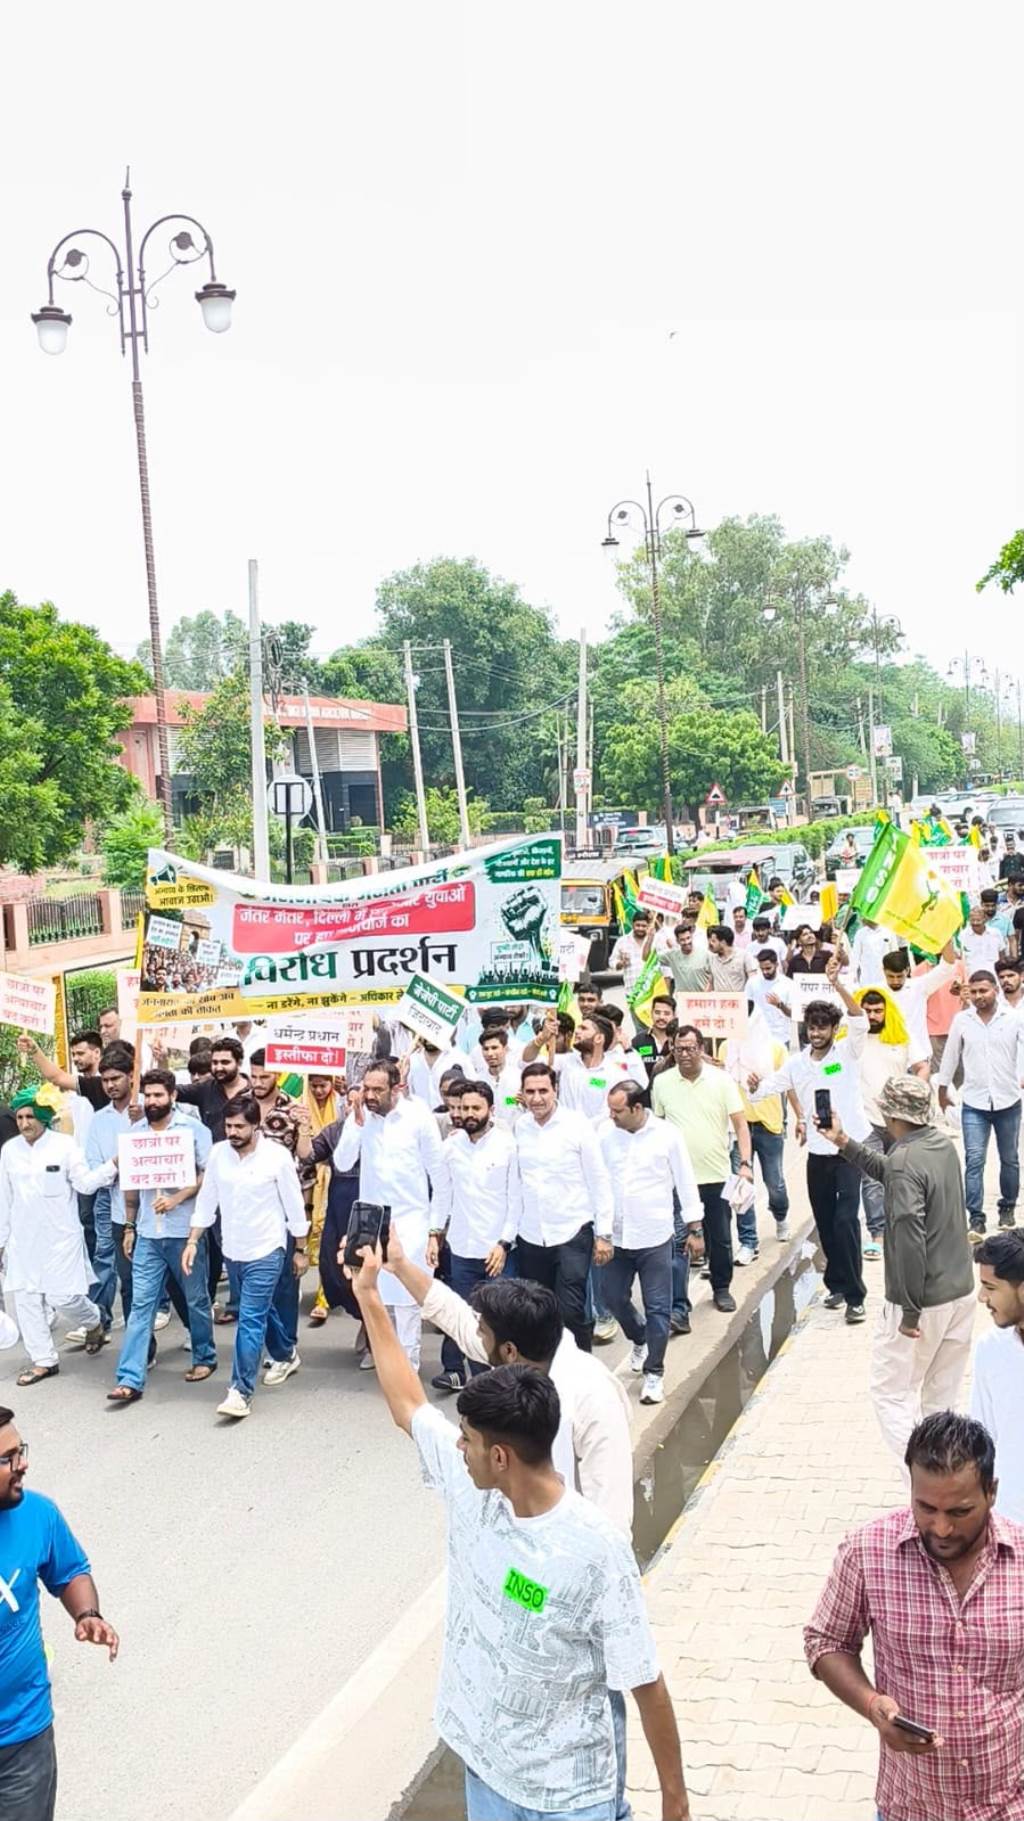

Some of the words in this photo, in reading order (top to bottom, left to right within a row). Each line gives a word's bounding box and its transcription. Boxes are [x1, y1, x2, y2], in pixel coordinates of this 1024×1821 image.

[241, 950, 339, 986] विरोध
[351, 936, 459, 979] प्रदर्शन
[505, 1569, 545, 1608] INSO
